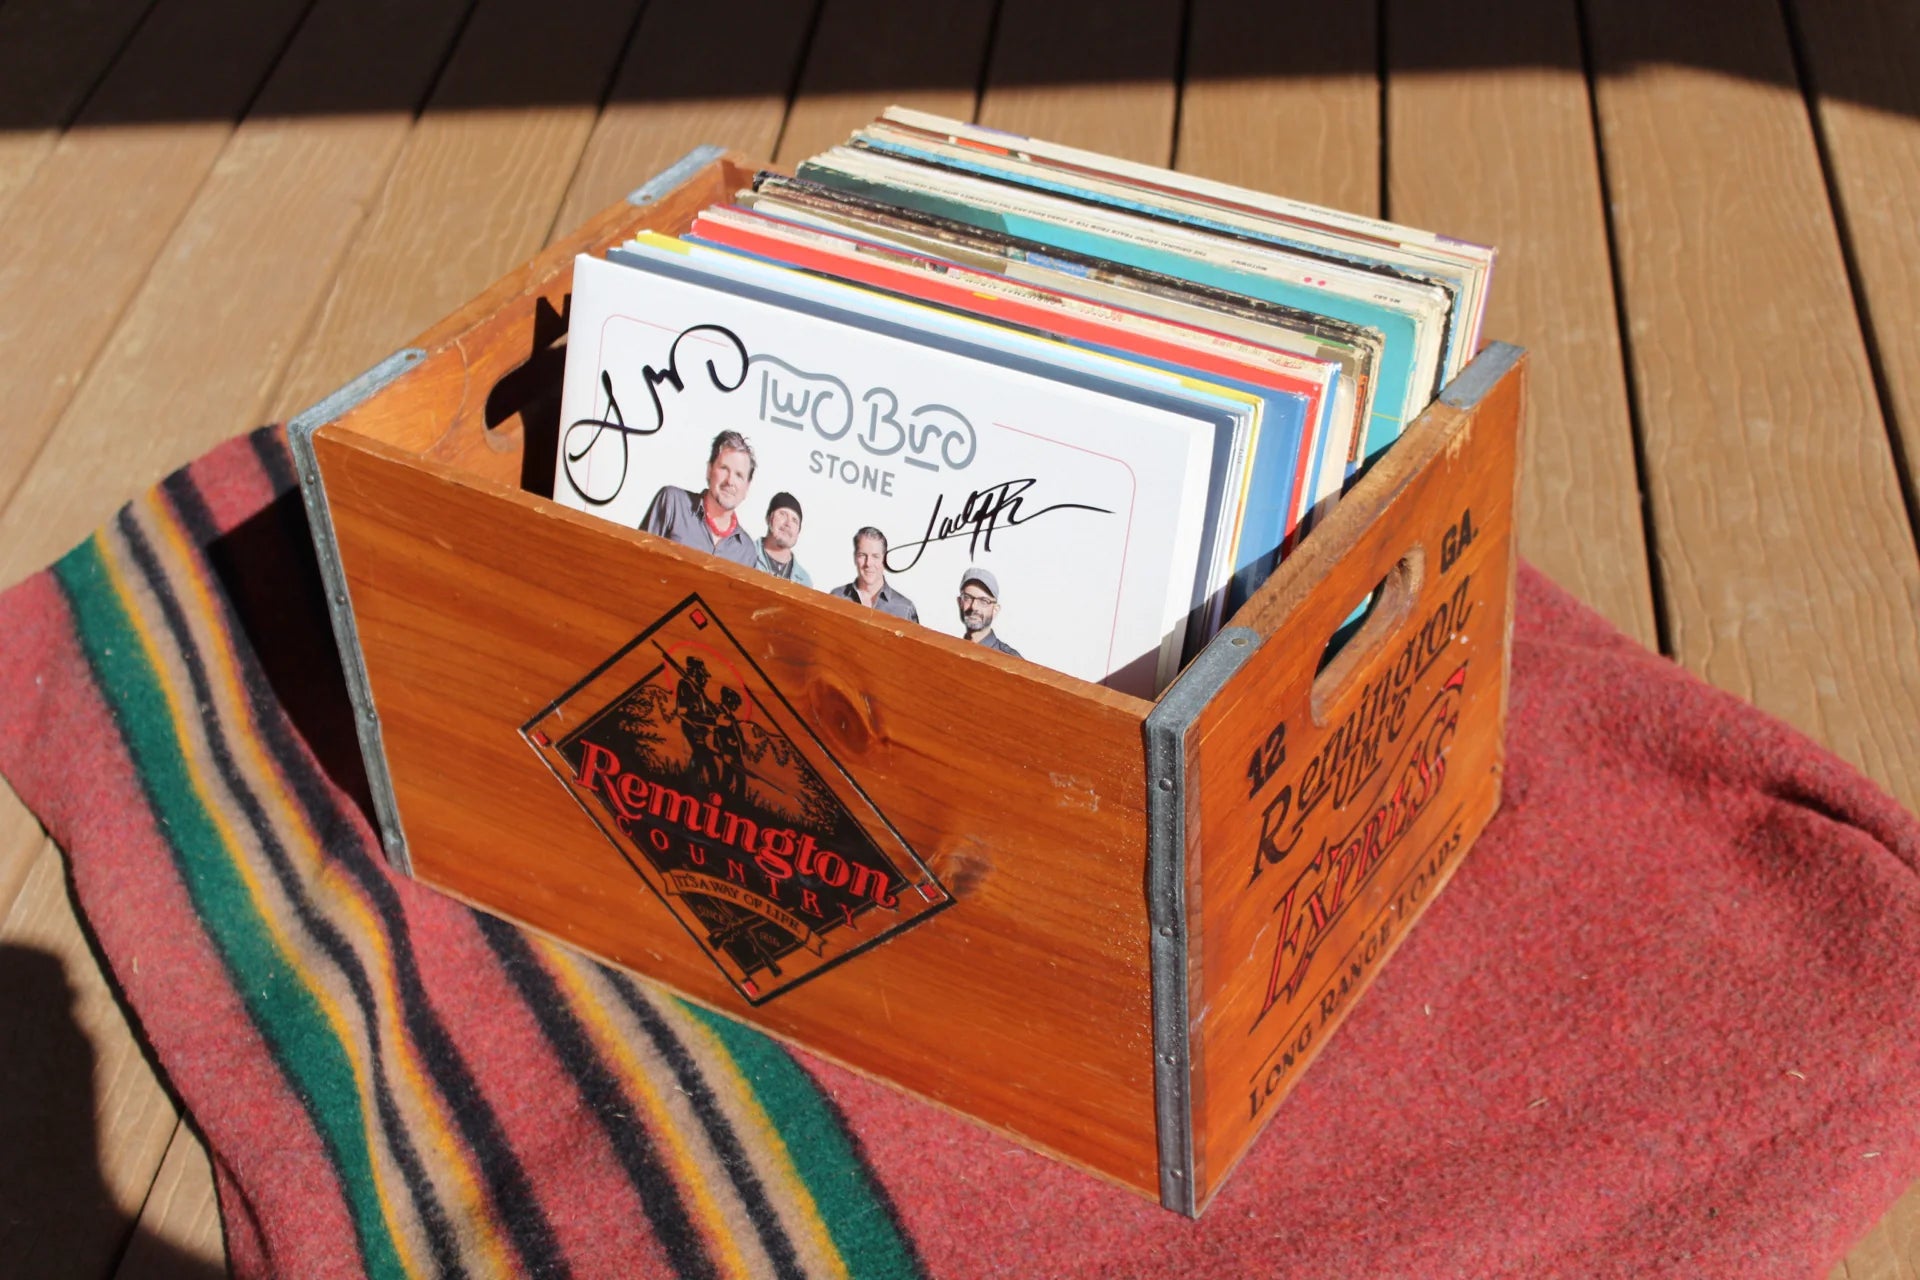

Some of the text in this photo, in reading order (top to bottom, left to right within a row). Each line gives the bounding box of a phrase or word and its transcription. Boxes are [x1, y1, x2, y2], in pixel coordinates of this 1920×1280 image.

[808, 450, 897, 498] STONE
[1246, 508, 1480, 800] 12 GA.
[1248, 575, 1475, 888] Remington
[573, 738, 898, 910] Remington
[614, 814, 861, 931] COUNTRY
[709, 880, 739, 899] WAY
[742, 893, 763, 909] OF
[764, 902, 800, 931] LIFE
[1249, 659, 1470, 1036] EXPRESS
[1250, 821, 1463, 1121] LONG RANGE LOADS
